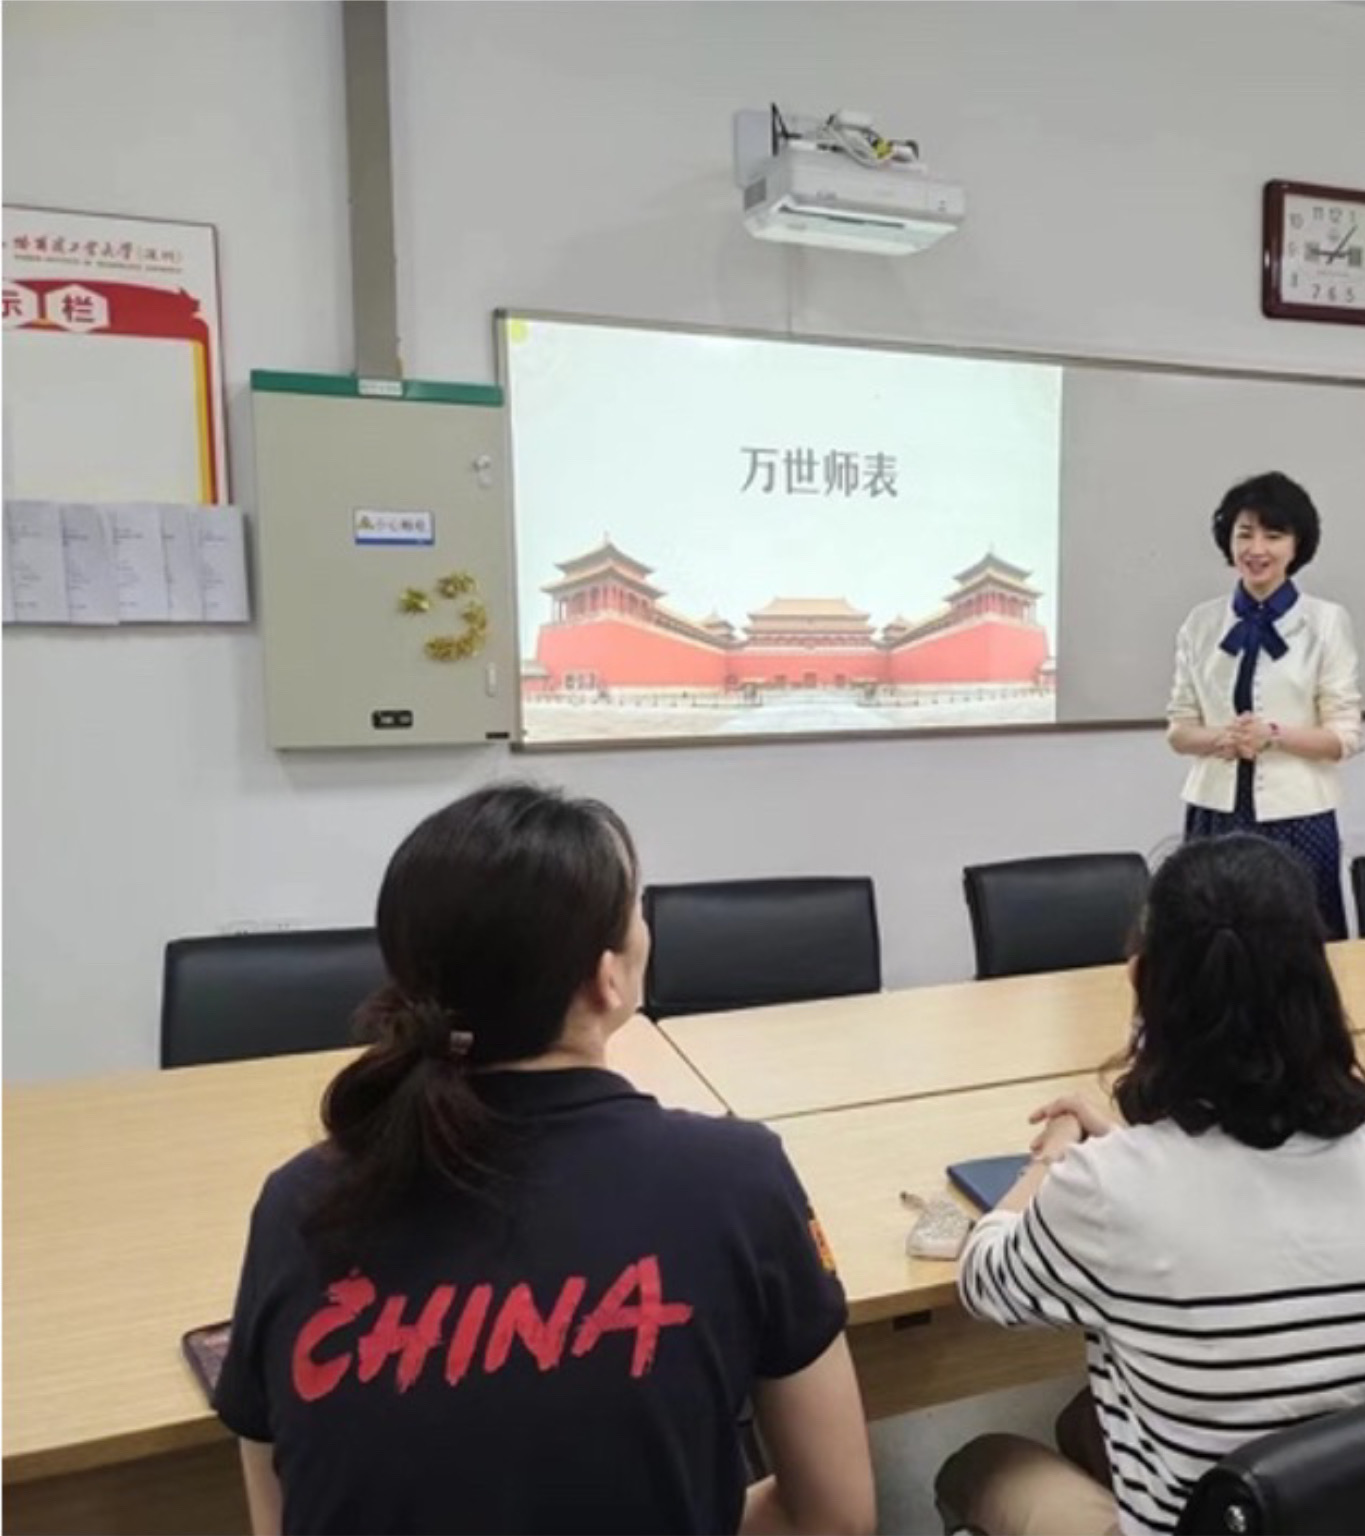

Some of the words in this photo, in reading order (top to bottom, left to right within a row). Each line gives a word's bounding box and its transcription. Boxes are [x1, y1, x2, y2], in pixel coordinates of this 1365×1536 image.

[740, 447, 898, 498] 万世师表
[290, 1255, 693, 1401] CHINA
